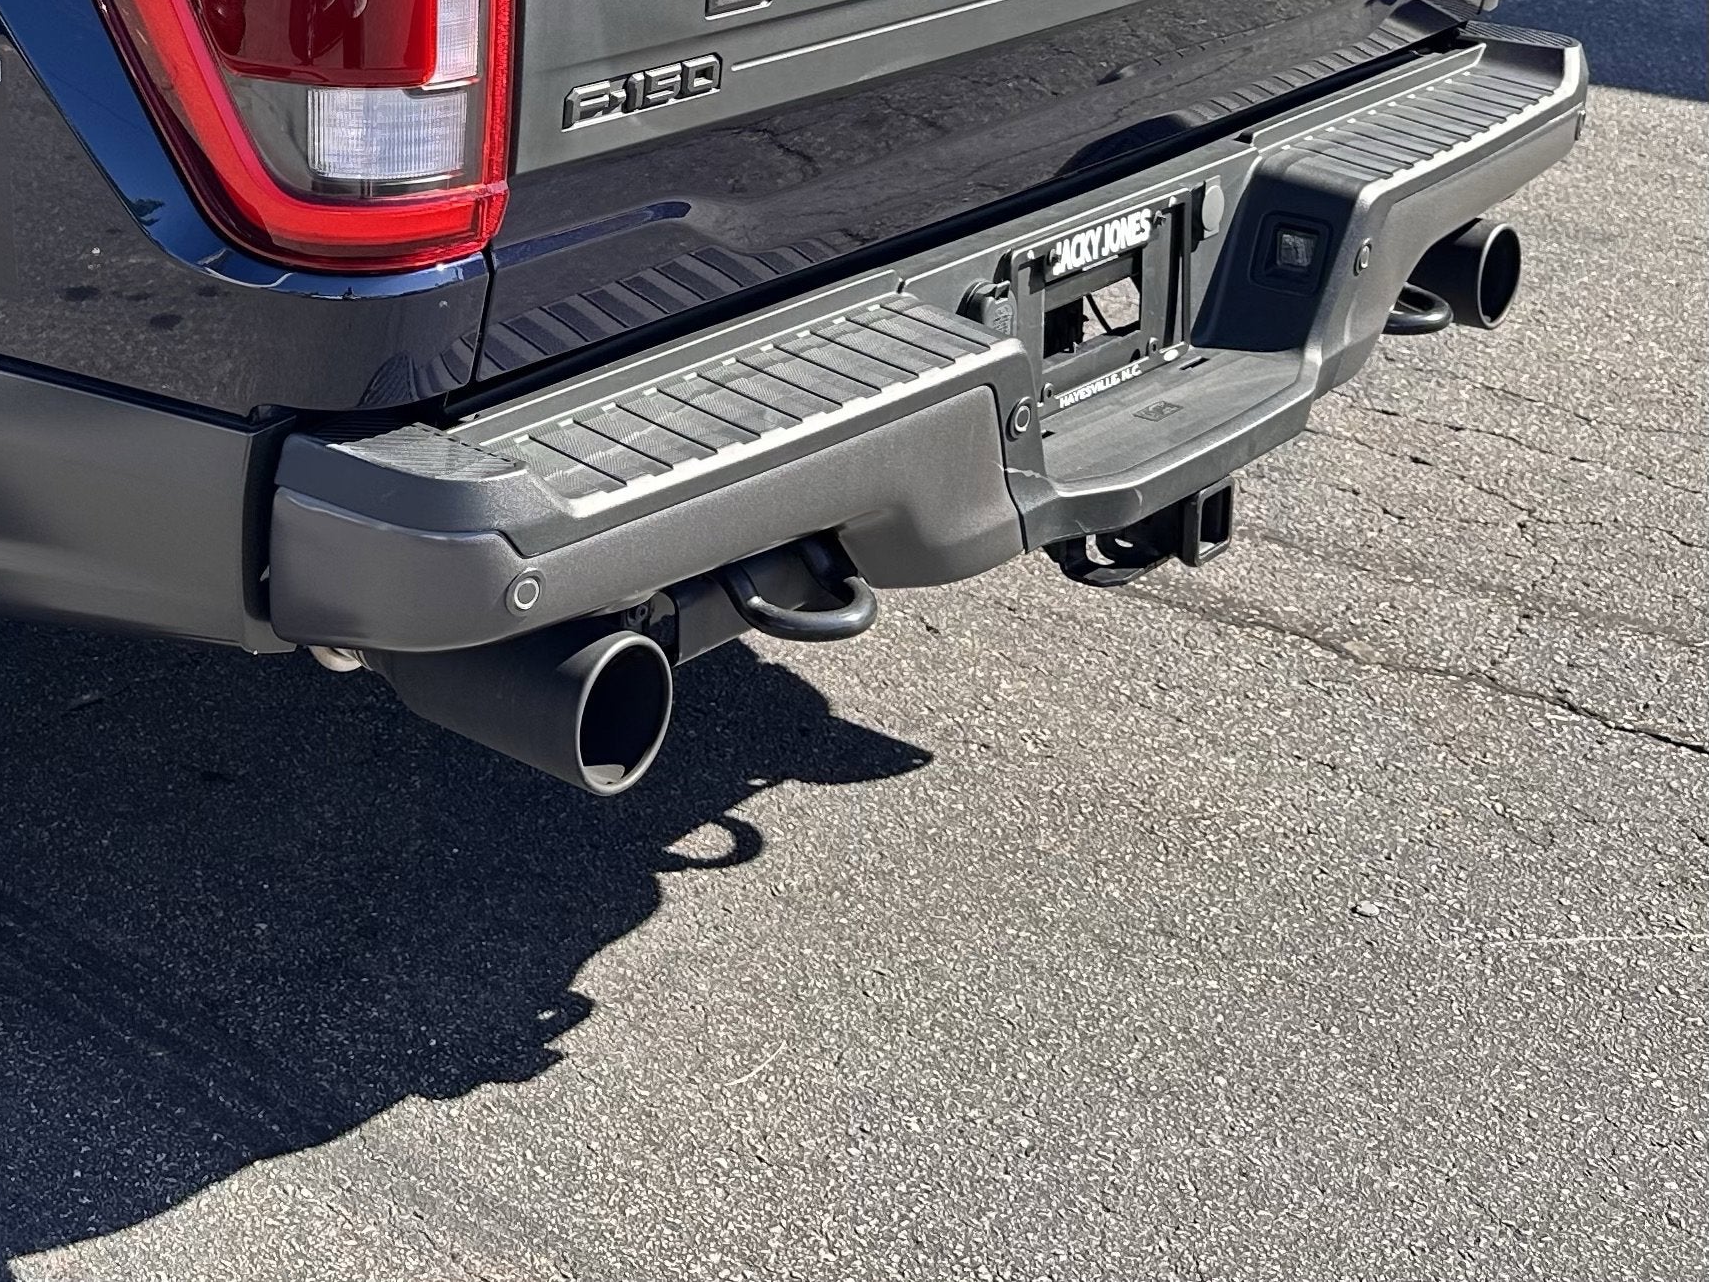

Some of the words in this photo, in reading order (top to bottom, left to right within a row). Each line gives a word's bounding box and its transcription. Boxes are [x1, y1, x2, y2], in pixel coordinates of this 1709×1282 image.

[561, 51, 723, 133] F-150
[1052, 225, 1103, 276] JACKY
[1101, 208, 1152, 257] JONES
